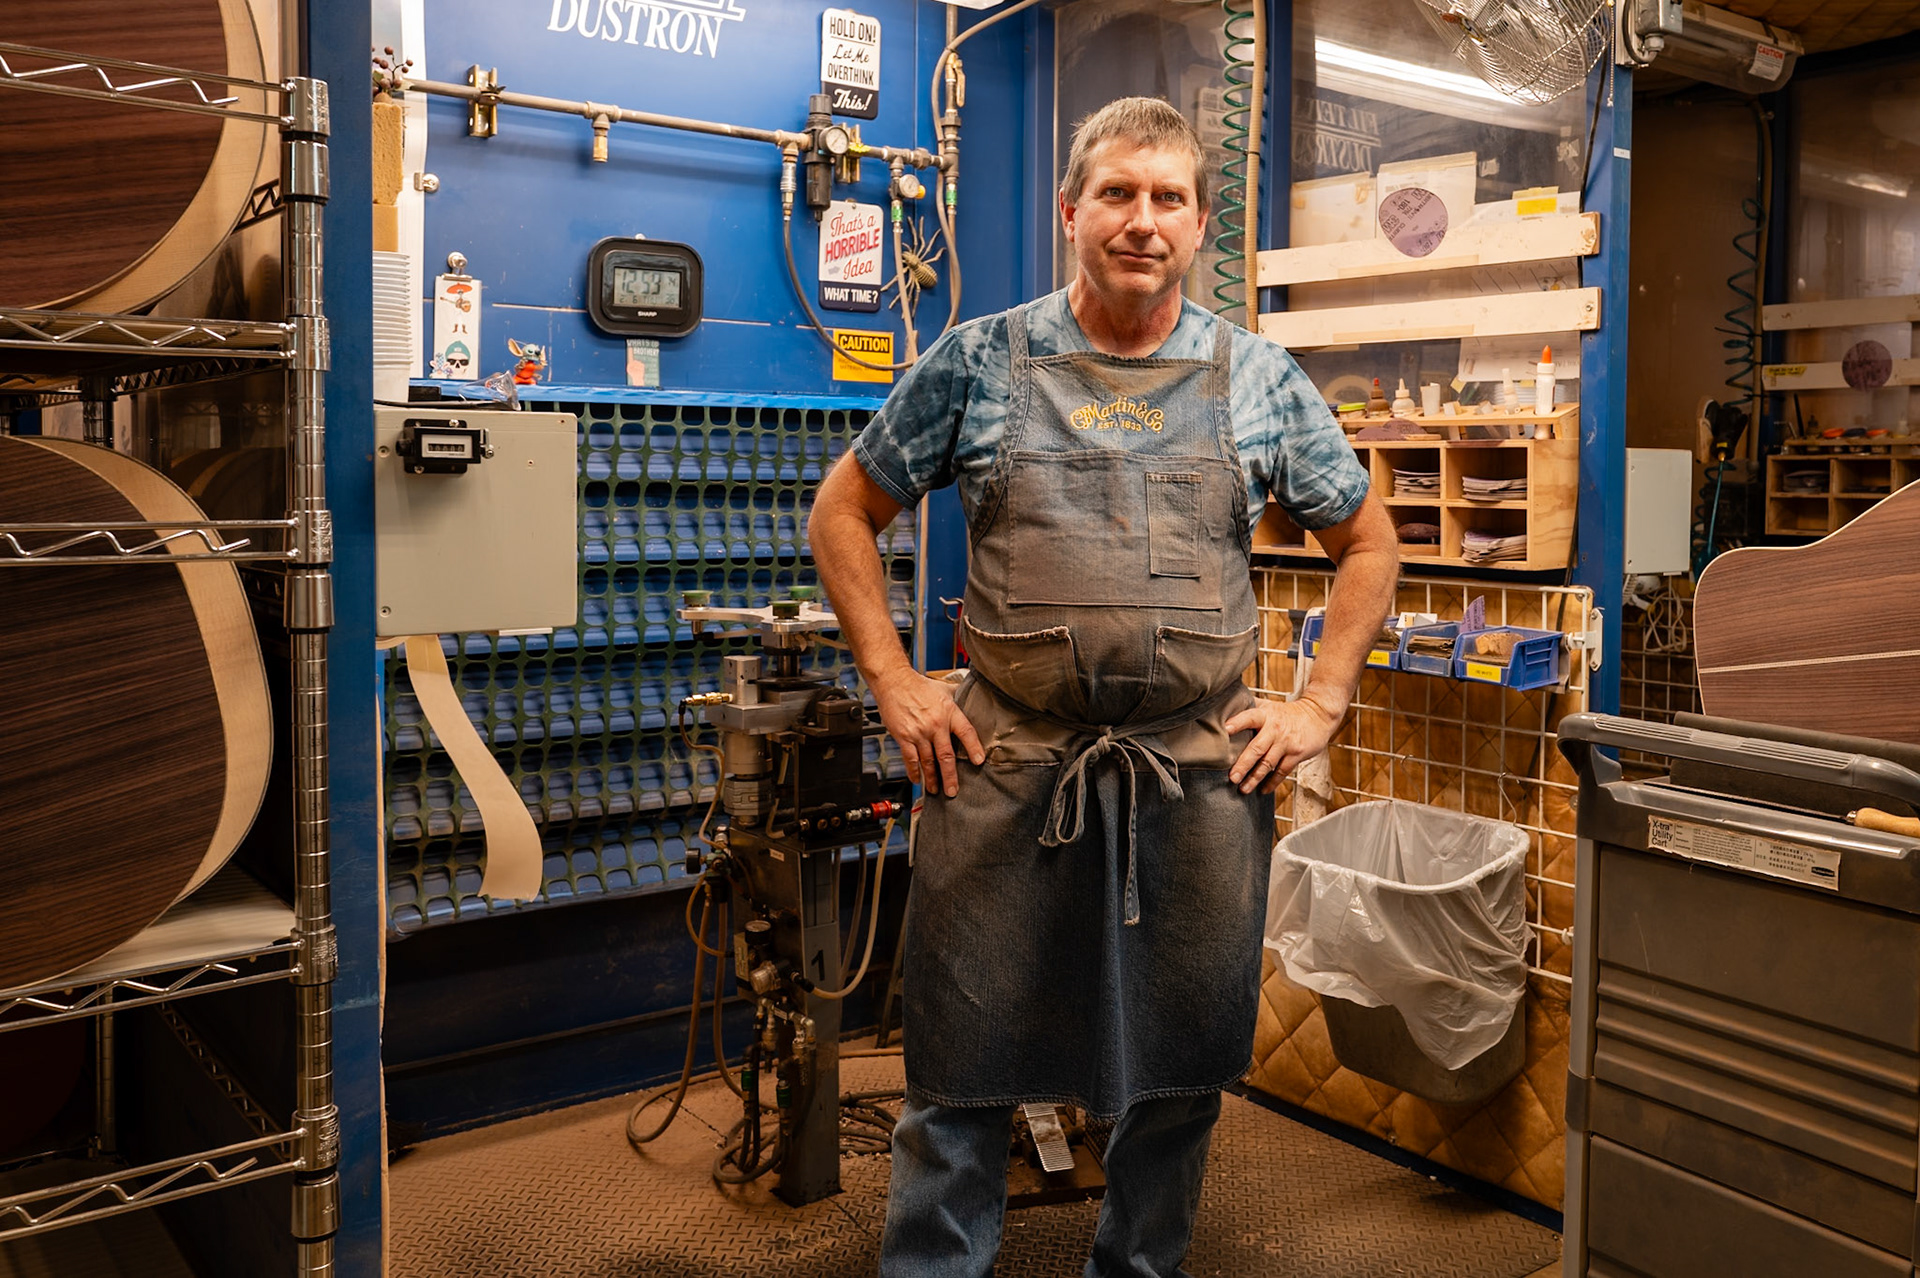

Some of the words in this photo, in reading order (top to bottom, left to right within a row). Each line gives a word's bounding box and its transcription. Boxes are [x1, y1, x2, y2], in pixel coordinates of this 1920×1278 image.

[547, 0, 724, 59] DUSTRON
[829, 16, 856, 39] HOLD
[858, 22, 877, 43] ON!
[832, 44, 852, 60] Let
[851, 48, 870, 63] Me
[827, 63, 875, 86] OVERTHINK
[832, 88, 873, 111] This!
[830, 211, 864, 237] That's
[867, 215, 877, 228] a
[825, 228, 880, 263] HORRIBLE
[843, 257, 875, 281] Idea
[824, 286, 850, 302] WHAT
[851, 288, 879, 304] TIME?
[840, 335, 889, 352] CAUTION
[1121, 420, 1142, 432] 1833
[1651, 837, 1668, 848] Cart
[1652, 829, 1674, 842] Utility
[811, 949, 826, 981] 1
